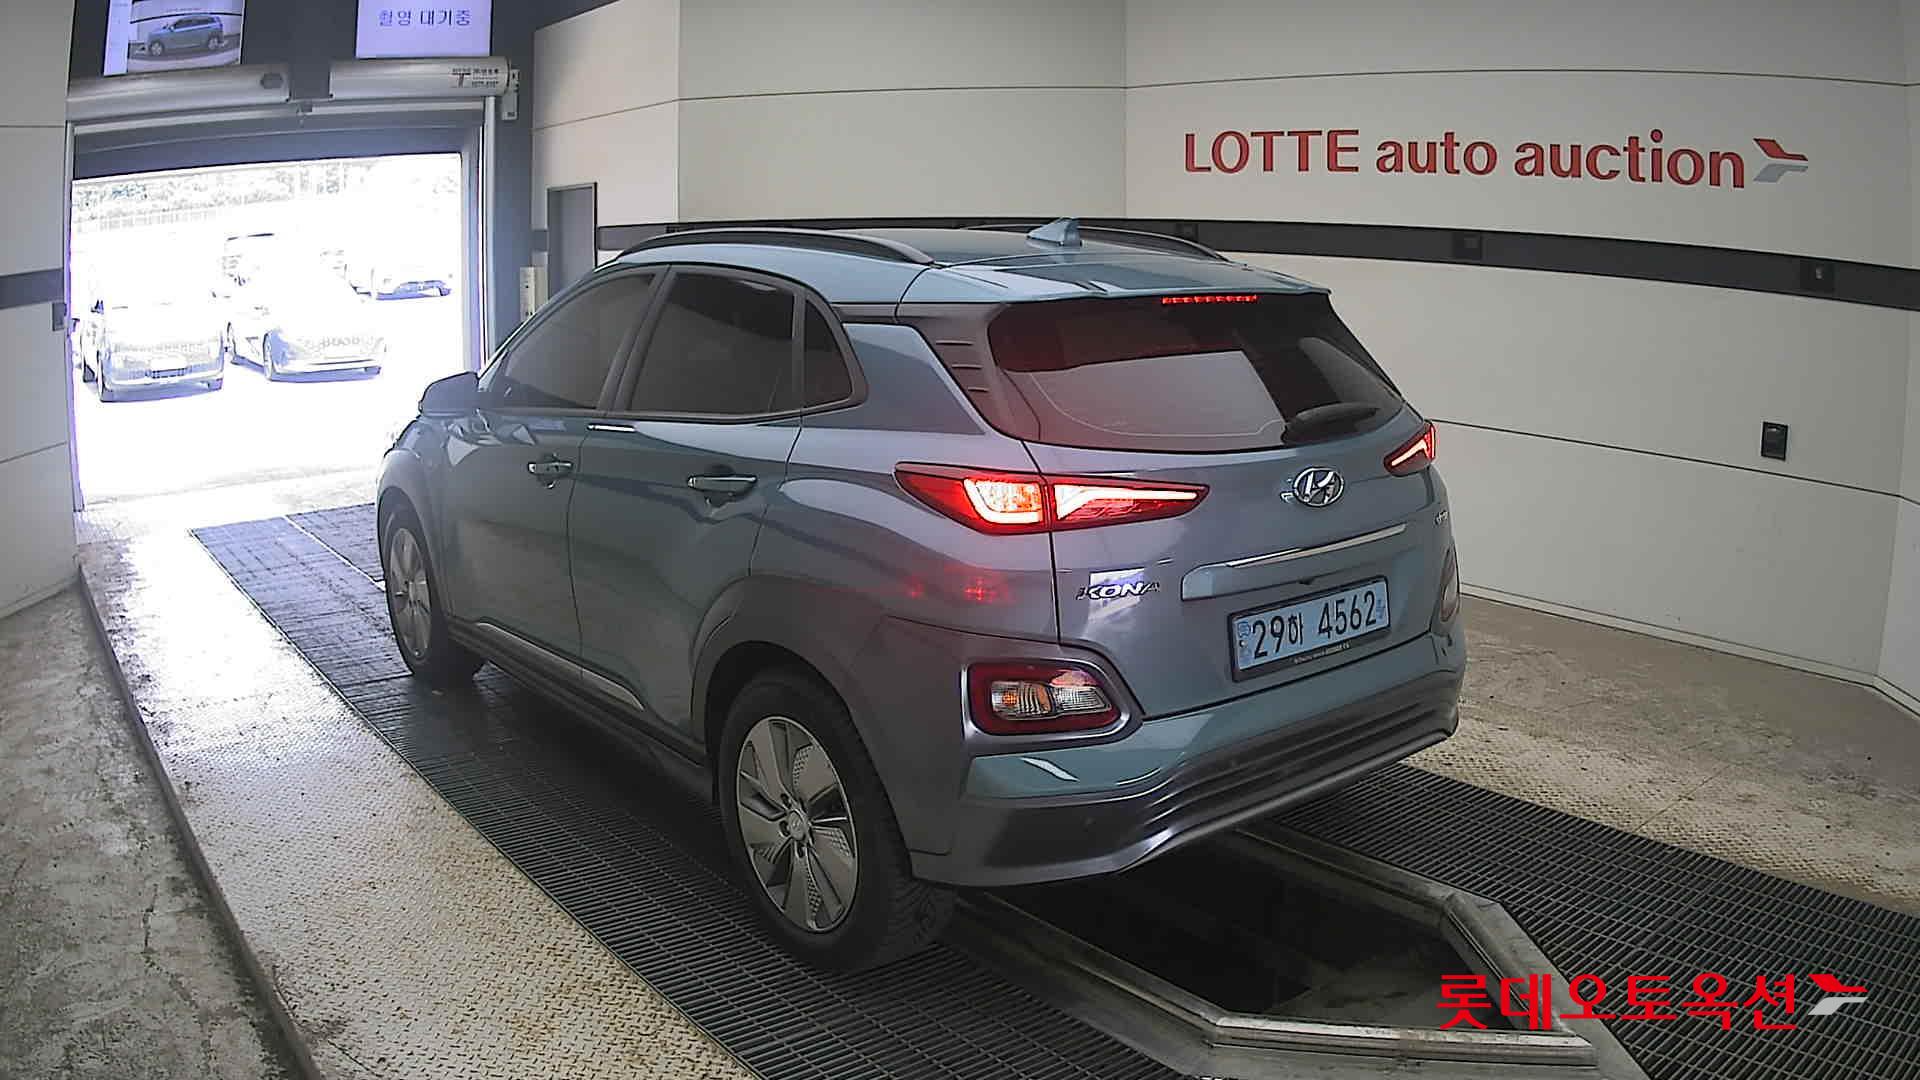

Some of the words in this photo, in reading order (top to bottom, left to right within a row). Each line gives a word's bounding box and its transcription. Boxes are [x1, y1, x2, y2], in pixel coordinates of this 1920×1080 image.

[420, 9, 472, 26] 대기중
[1184, 129, 1357, 174] LOTTE
[1377, 132, 1498, 175] auto
[1515, 130, 1745, 187] auction
[1075, 581, 1161, 600] KONA
[1252, 612, 1304, 659] 29하
[1318, 590, 1377, 639] 4562
